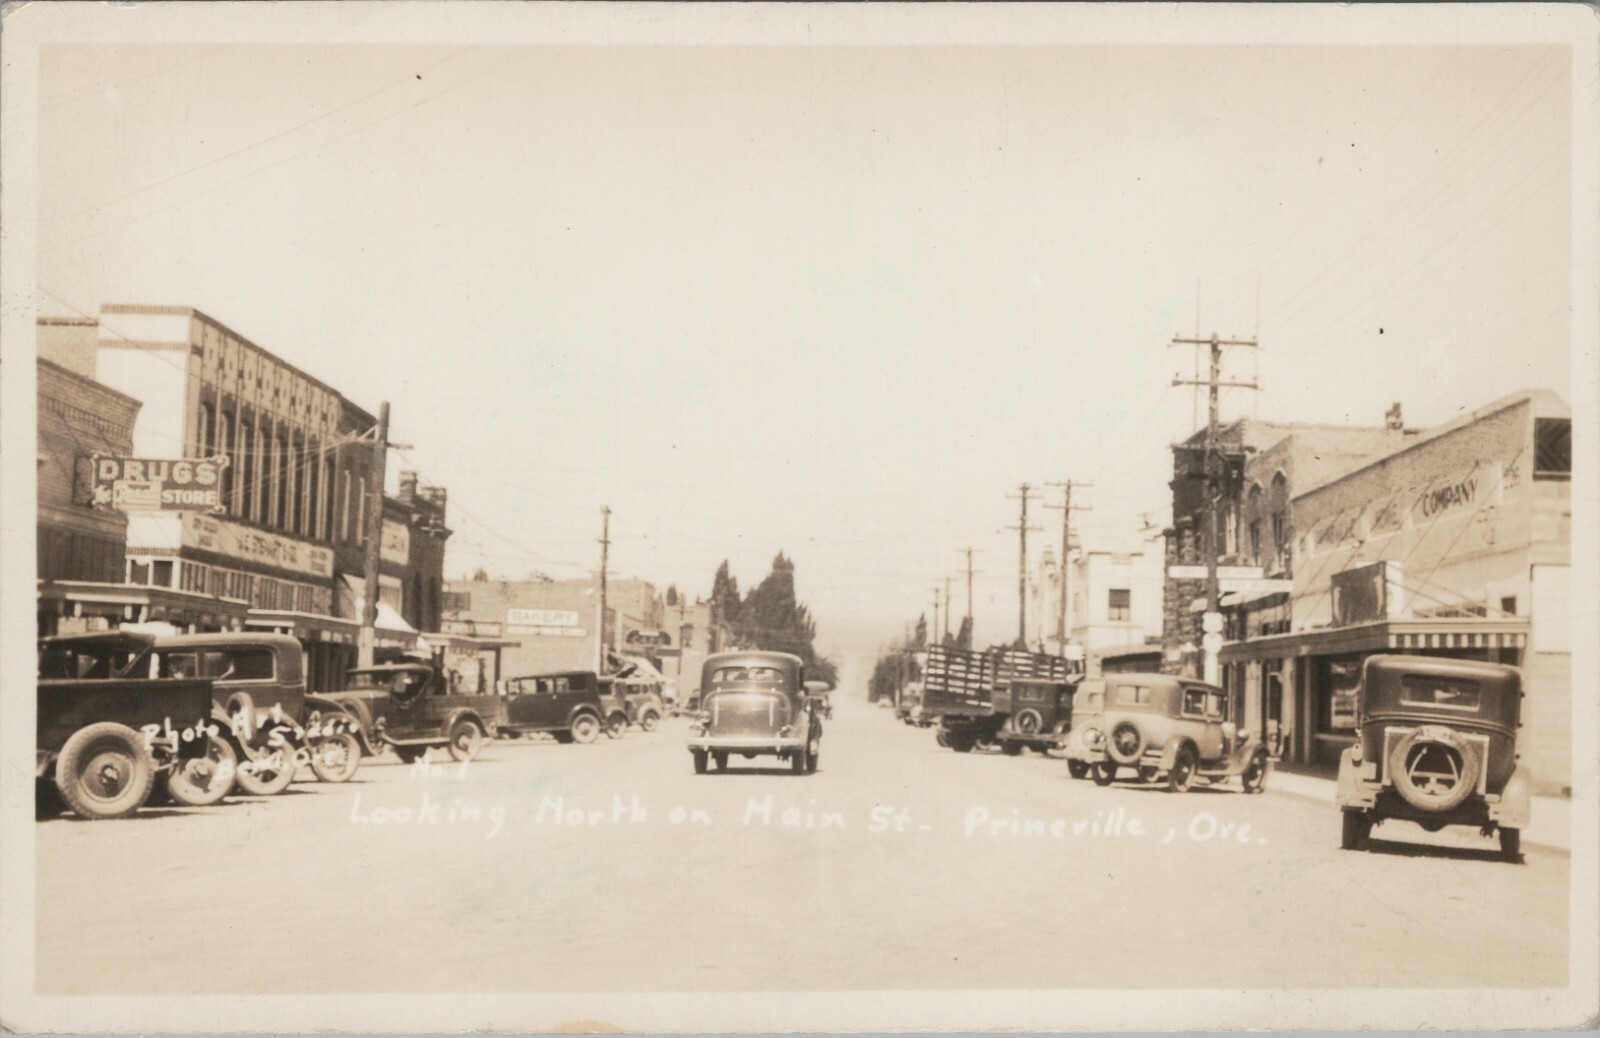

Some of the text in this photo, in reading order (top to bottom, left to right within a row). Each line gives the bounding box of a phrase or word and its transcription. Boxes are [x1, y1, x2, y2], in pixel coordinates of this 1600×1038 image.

[99, 459, 217, 485] DRUGS
[161, 488, 217, 505] STORE
[1422, 479, 1479, 518] COMPANY
[511, 611, 573, 624] BAKERY
